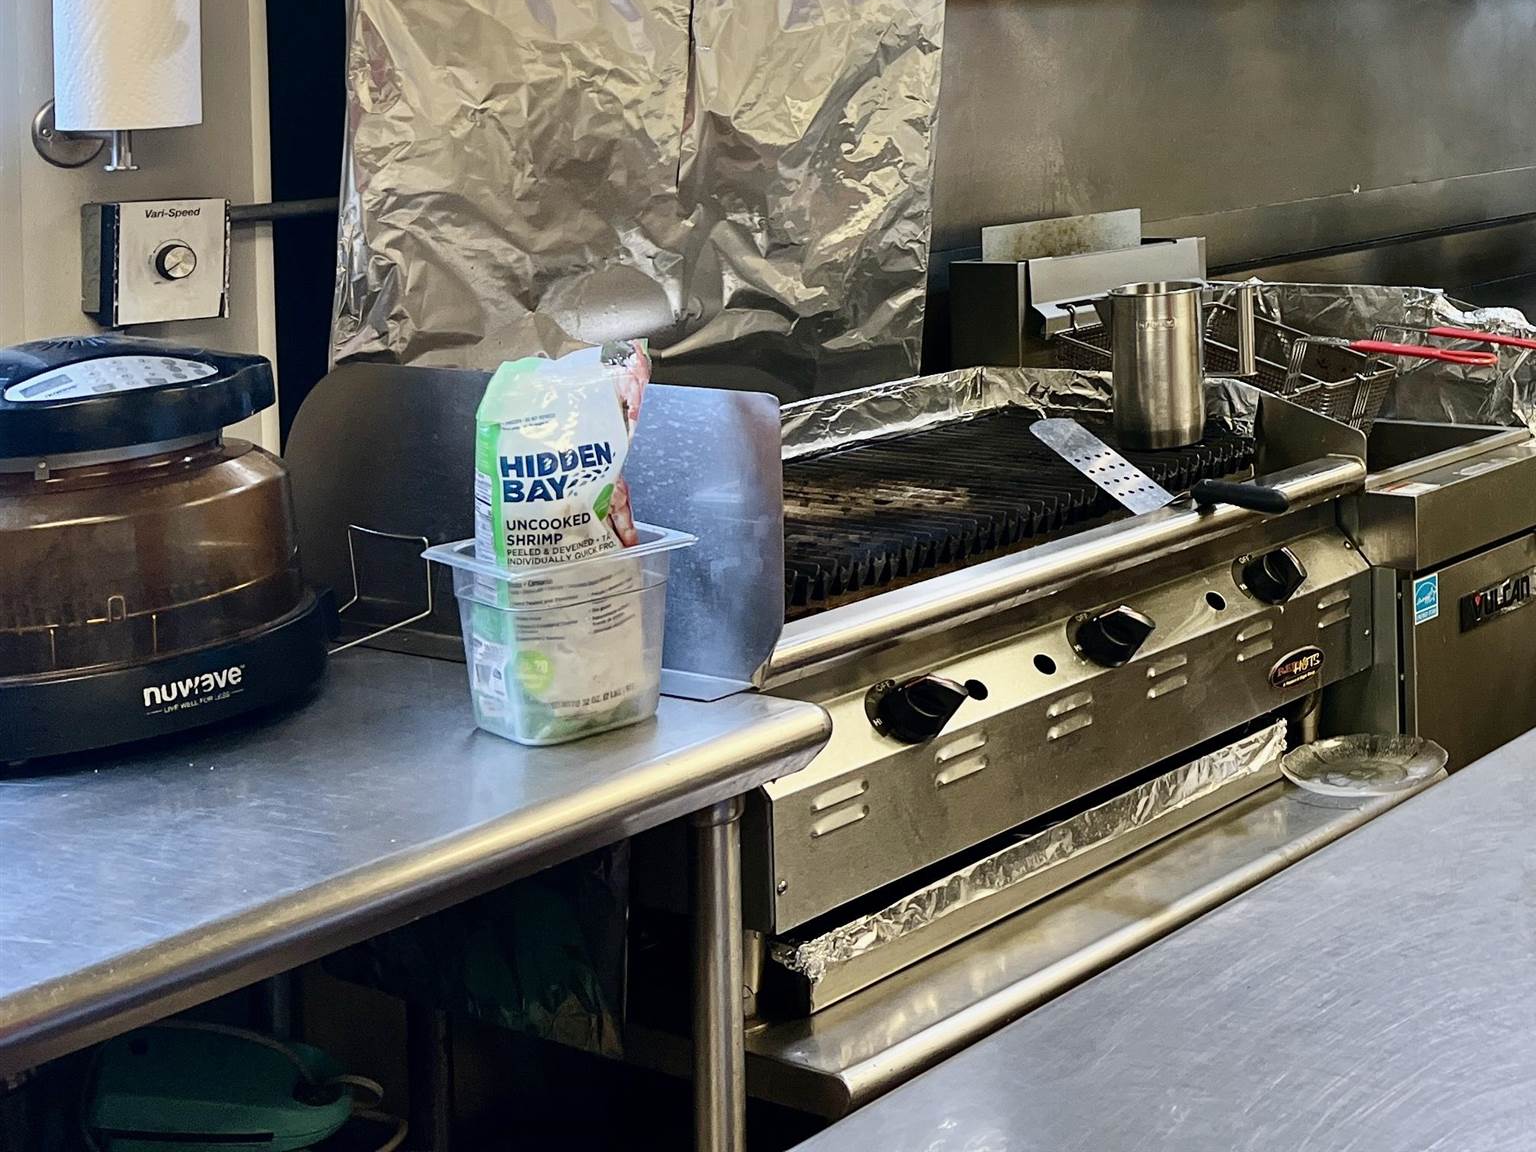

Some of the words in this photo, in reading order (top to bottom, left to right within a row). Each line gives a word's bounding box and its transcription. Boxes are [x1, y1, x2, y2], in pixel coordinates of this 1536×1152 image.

[145, 207, 201, 219] Vari-Speed
[499, 441, 612, 479] HIDDEN
[503, 474, 569, 504] BAY
[506, 511, 591, 531] UNCOOKED
[506, 533, 563, 546] SHRIMP
[507, 547, 541, 557] PEELED
[543, 547, 550, 555] &
[552, 537, 595, 555] DEVEINED
[507, 553, 572, 566] INDIVIDUALLY
[574, 549, 597, 560] QUICK
[1473, 574, 1531, 618] VULCAN
[143, 666, 242, 708] nuwave
